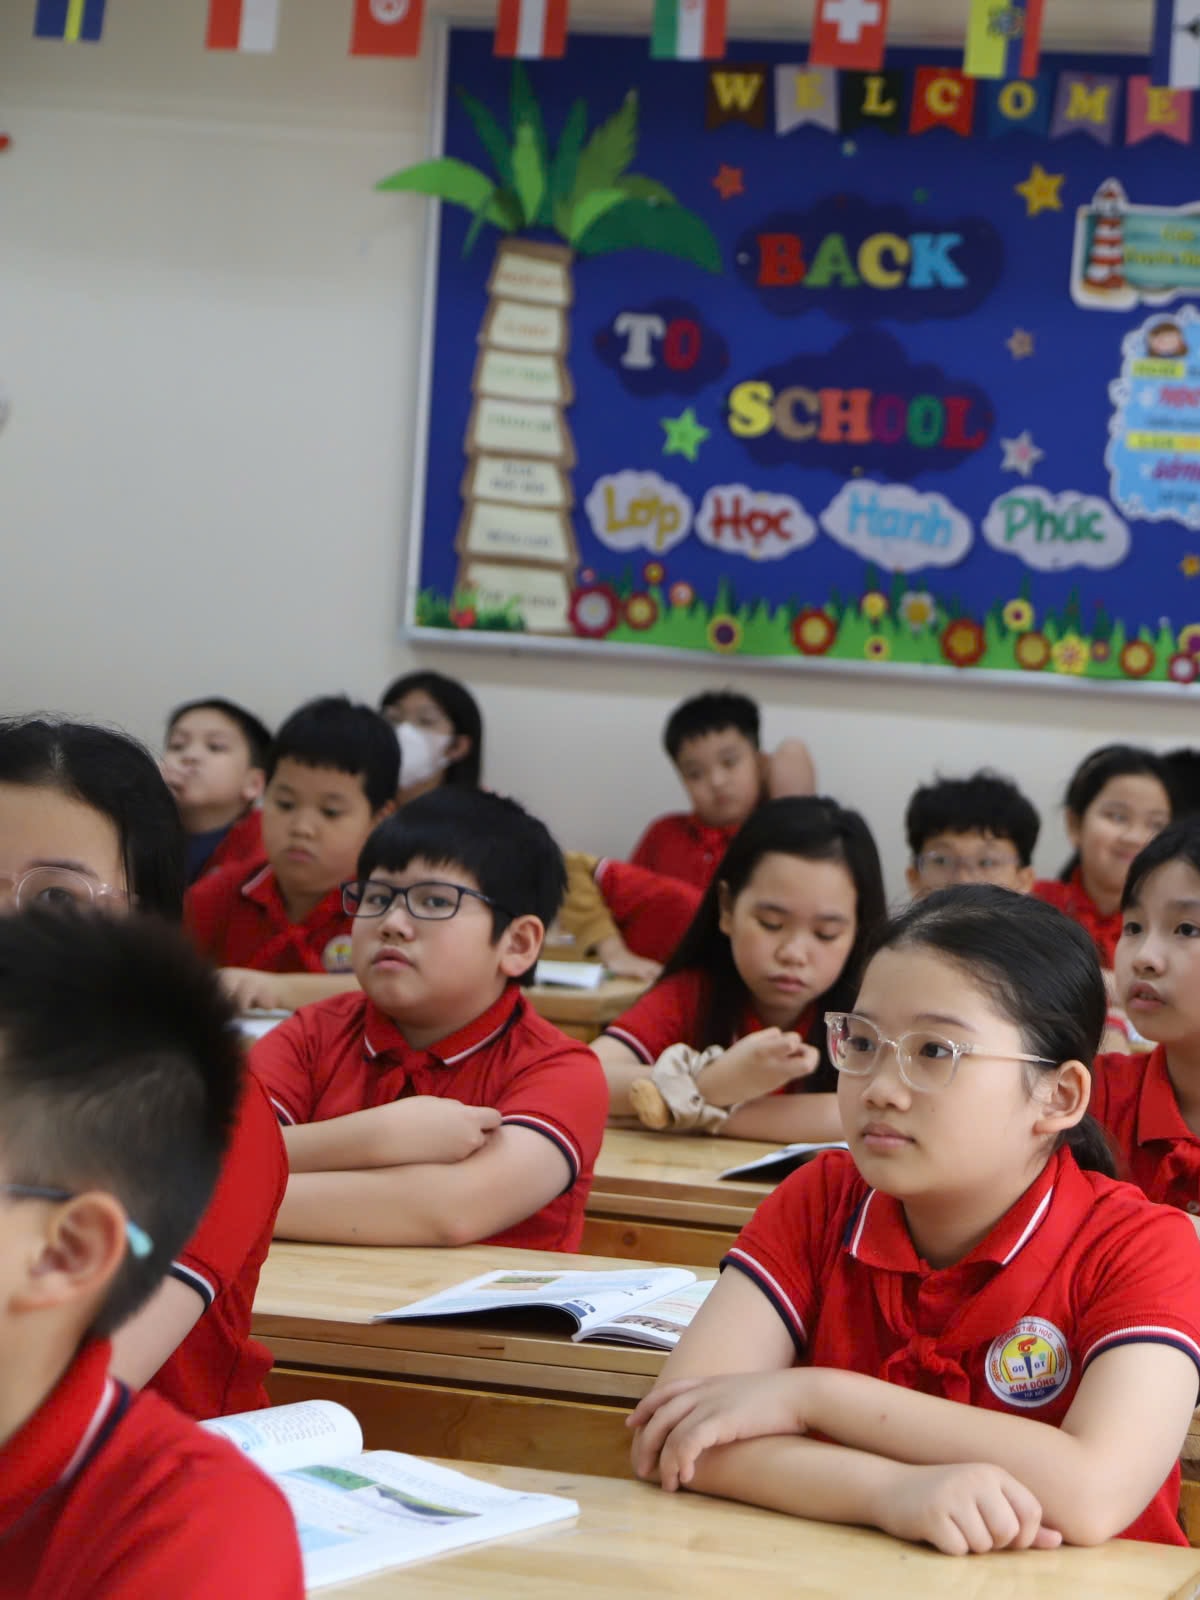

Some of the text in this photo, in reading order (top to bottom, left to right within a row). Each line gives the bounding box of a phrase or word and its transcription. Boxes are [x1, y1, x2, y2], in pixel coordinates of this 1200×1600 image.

[712, 72, 1181, 125] WELCOME
[757, 234, 966, 287] BACK
[614, 313, 702, 369] TO
[728, 381, 987, 449] SCHOOL
[709, 495, 793, 545] Học
[1009, 1383, 1028, 1393] KIM
